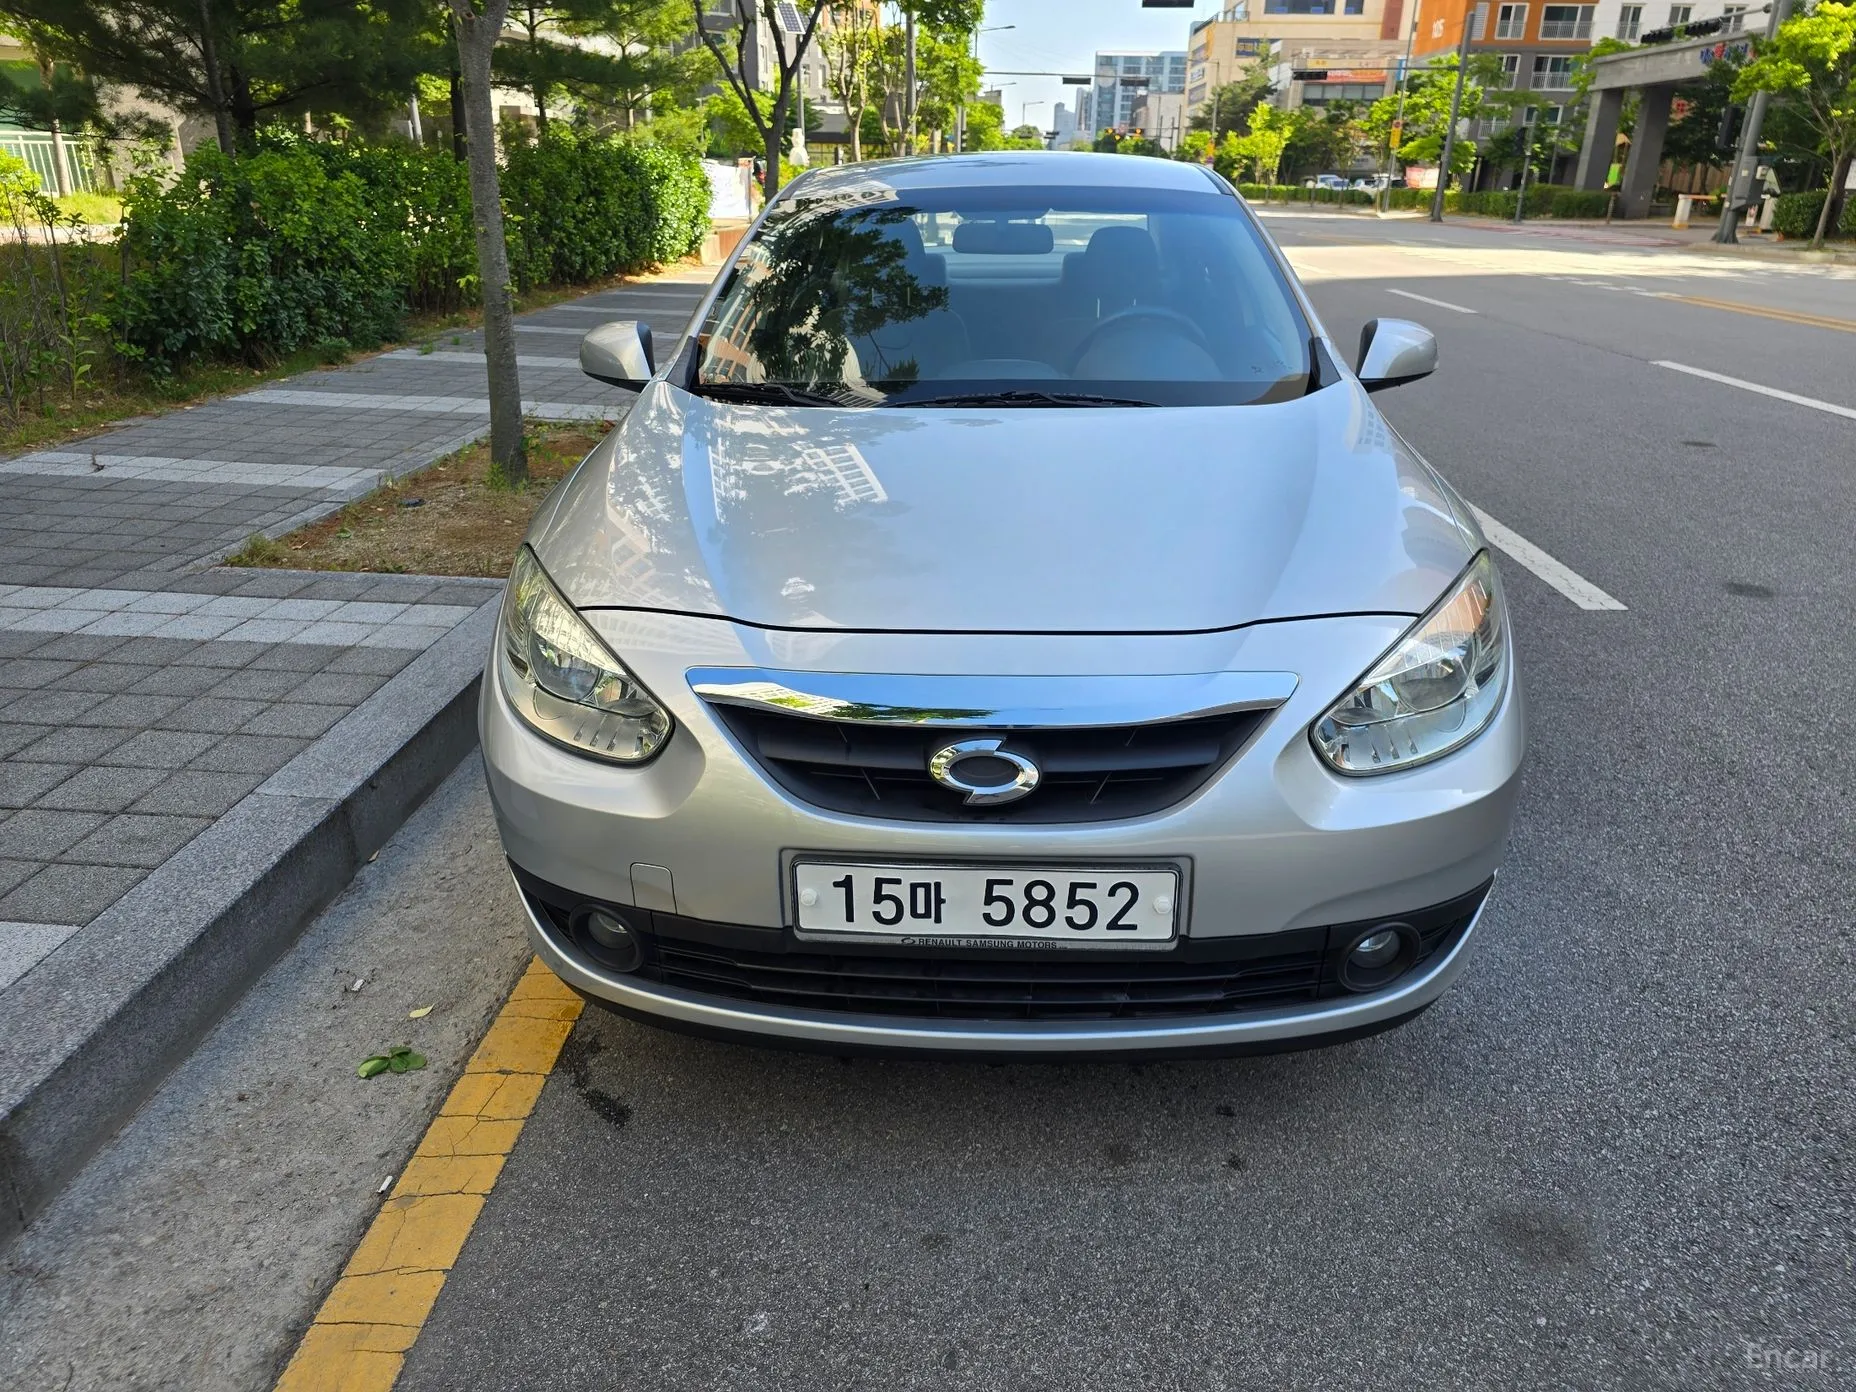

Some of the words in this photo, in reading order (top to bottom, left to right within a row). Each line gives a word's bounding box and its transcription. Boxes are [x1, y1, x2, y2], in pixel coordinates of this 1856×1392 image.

[832, 874, 947, 925] 15마
[982, 878, 1140, 932] 5852
[918, 938, 963, 947] RENAULT
[966, 939, 1014, 948] SAMSUNG
[1017, 940, 1057, 949] MOTORS
